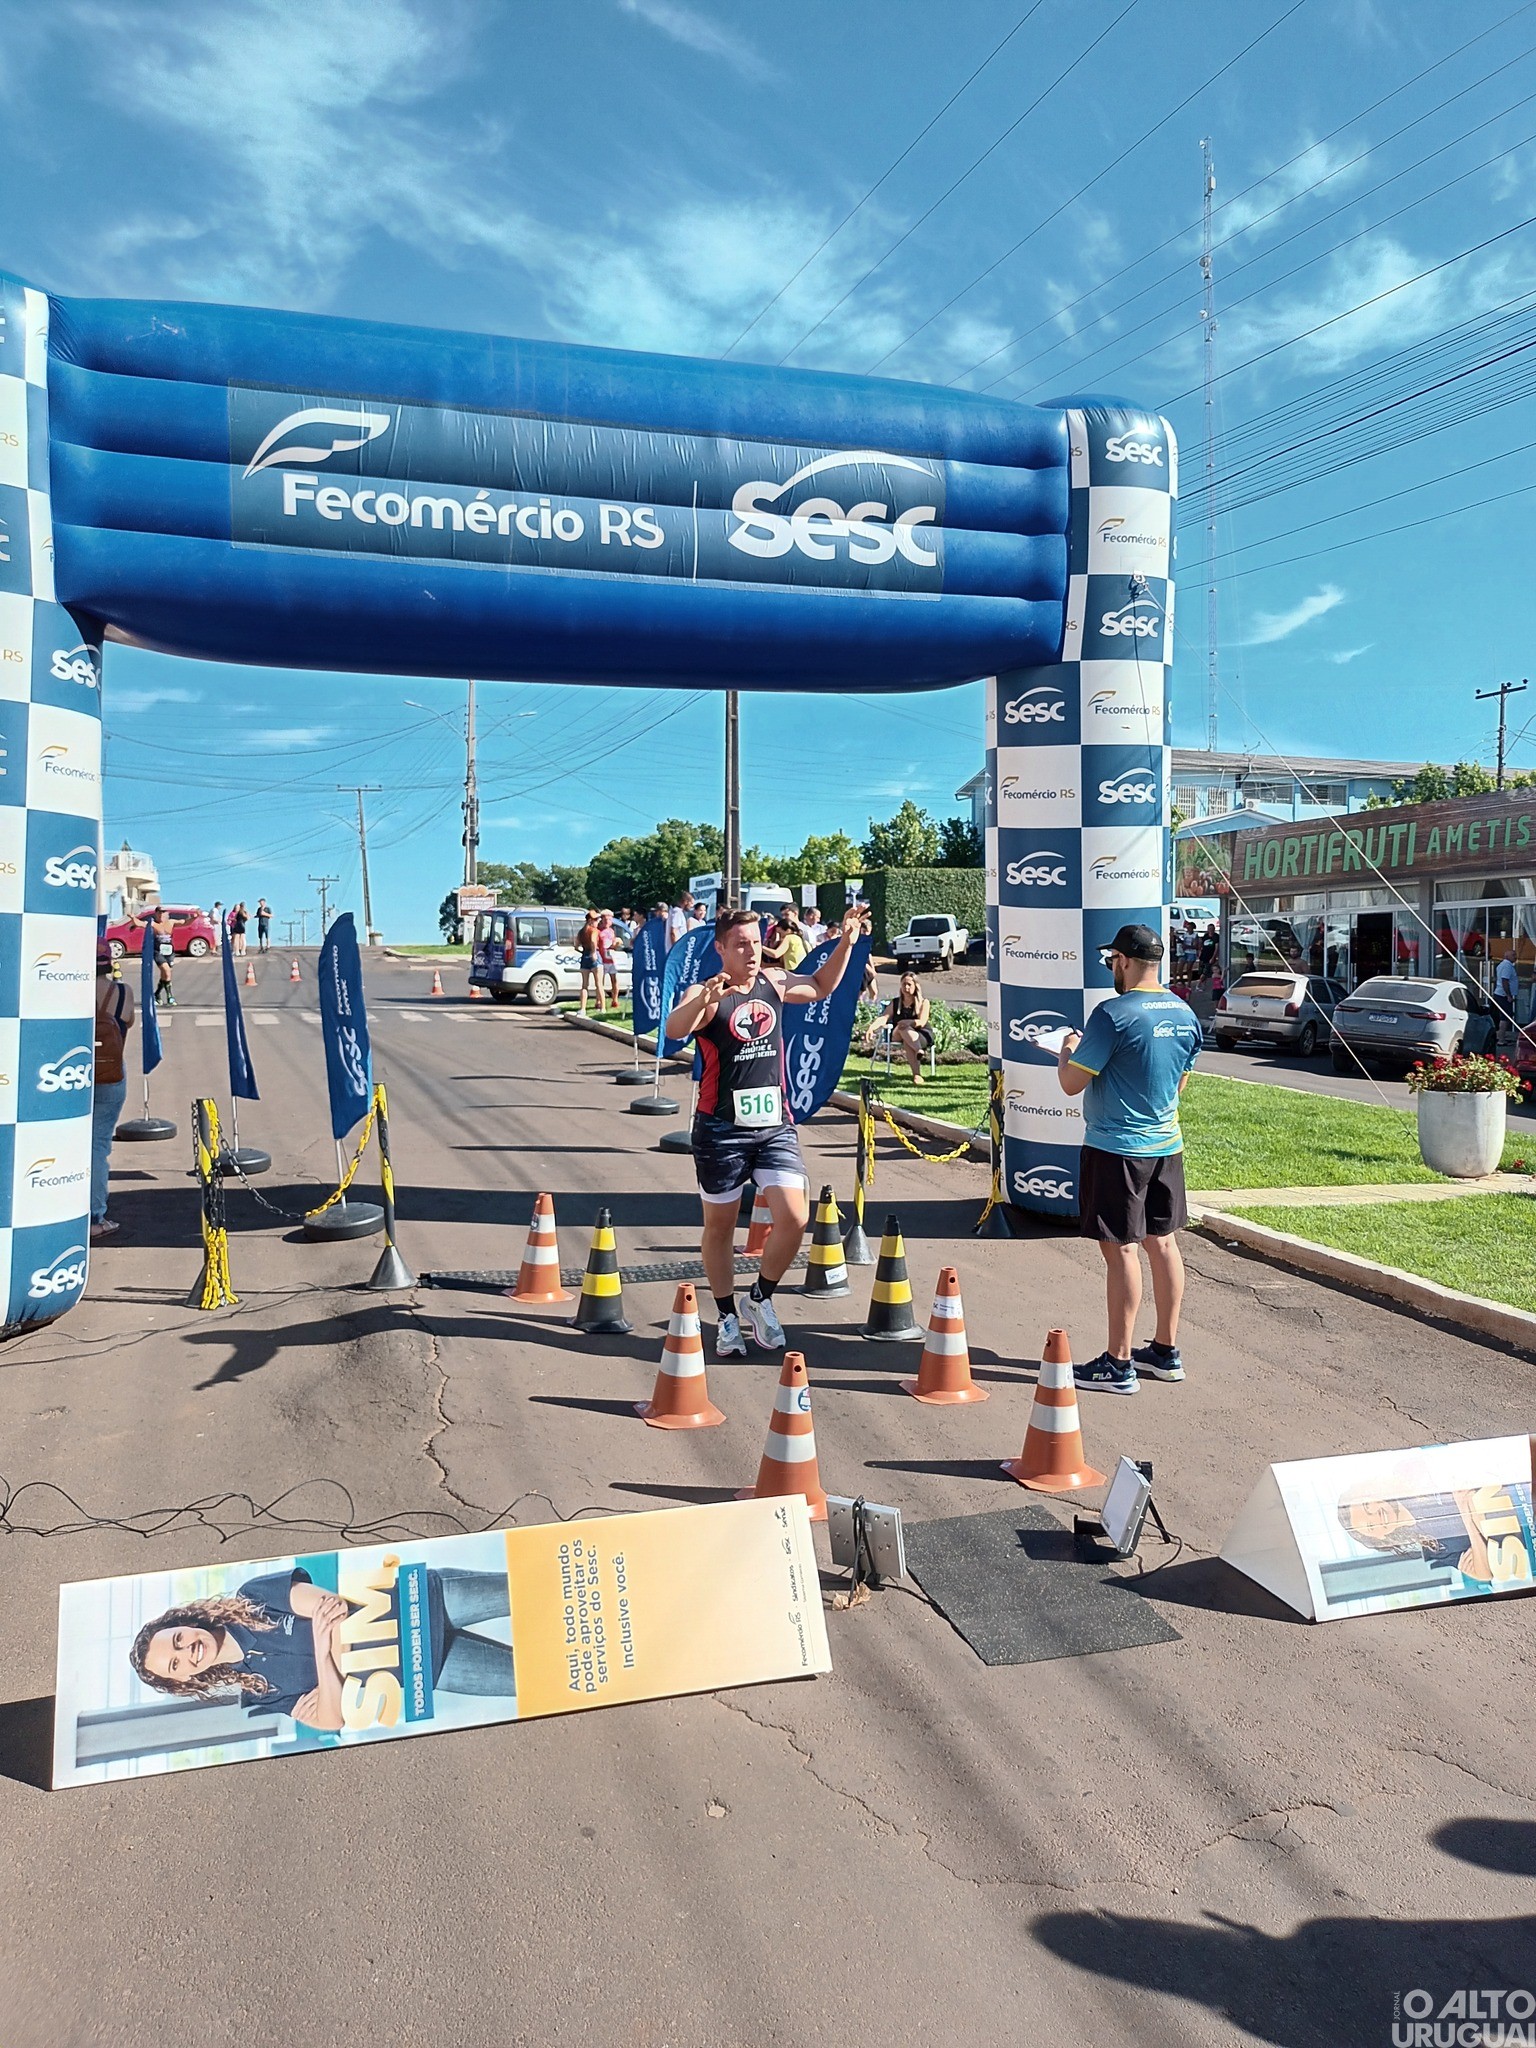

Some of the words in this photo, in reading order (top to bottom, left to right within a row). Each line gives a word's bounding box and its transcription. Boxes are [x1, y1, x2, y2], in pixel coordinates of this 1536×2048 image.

[1105, 424, 1164, 467] Sesc
[283, 472, 585, 542] Fecomércio
[600, 503, 665, 549] RS
[728, 450, 937, 567] Sesc
[1103, 532, 1157, 546] Fecomércio
[1099, 600, 1160, 638] Sesc
[3, 649, 24, 663] RS
[1004, 686, 1065, 724] Sesc
[1095, 702, 1151, 715] Fecomércio
[1151, 706, 1161, 716] RS
[1003, 788, 1057, 800] Fecomércio
[1060, 788, 1076, 799] RS
[1097, 767, 1157, 804] Sesc
[1243, 822, 1417, 881] HORTIFRUTI
[1427, 815, 1532, 855] AMETIS
[1005, 851, 1067, 886] Sesc
[1096, 868, 1150, 881] Fecomércio
[1151, 868, 1160, 878] RS
[1005, 946, 1059, 961] Fecomércio
[1061, 951, 1077, 961] RS
[641, 976, 661, 1020] Sesc
[786, 1034, 825, 1113] Sesc
[740, 1093, 774, 1116] 516
[1009, 1101, 1063, 1117] Fecomércio
[1065, 1107, 1081, 1118] RS
[1014, 1164, 1074, 1200] Sesc
[1092, 1371, 1113, 1381] FILA
[573, 1539, 583, 1558] os
[587, 1544, 599, 1585] Sesc.
[407, 1569, 420, 1603] SESC.
[558, 1544, 573, 1600] mundo
[612, 1551, 627, 1594] você.
[789, 1565, 799, 1602] Sindicatos
[408, 1603, 421, 1628] SER
[574, 1564, 592, 1645] aproveitar
[589, 1590, 601, 1612] do
[563, 1605, 577, 1645] todo
[618, 1598, 635, 1669] Inclusive
[410, 1629, 423, 1672] PODEM
[593, 1616, 608, 1683] serviços
[797, 1624, 808, 1667] Fecomércio
[566, 1649, 581, 1692] Aqui,
[580, 1650, 597, 1693] pode
[413, 1672, 425, 1717] TODOS
